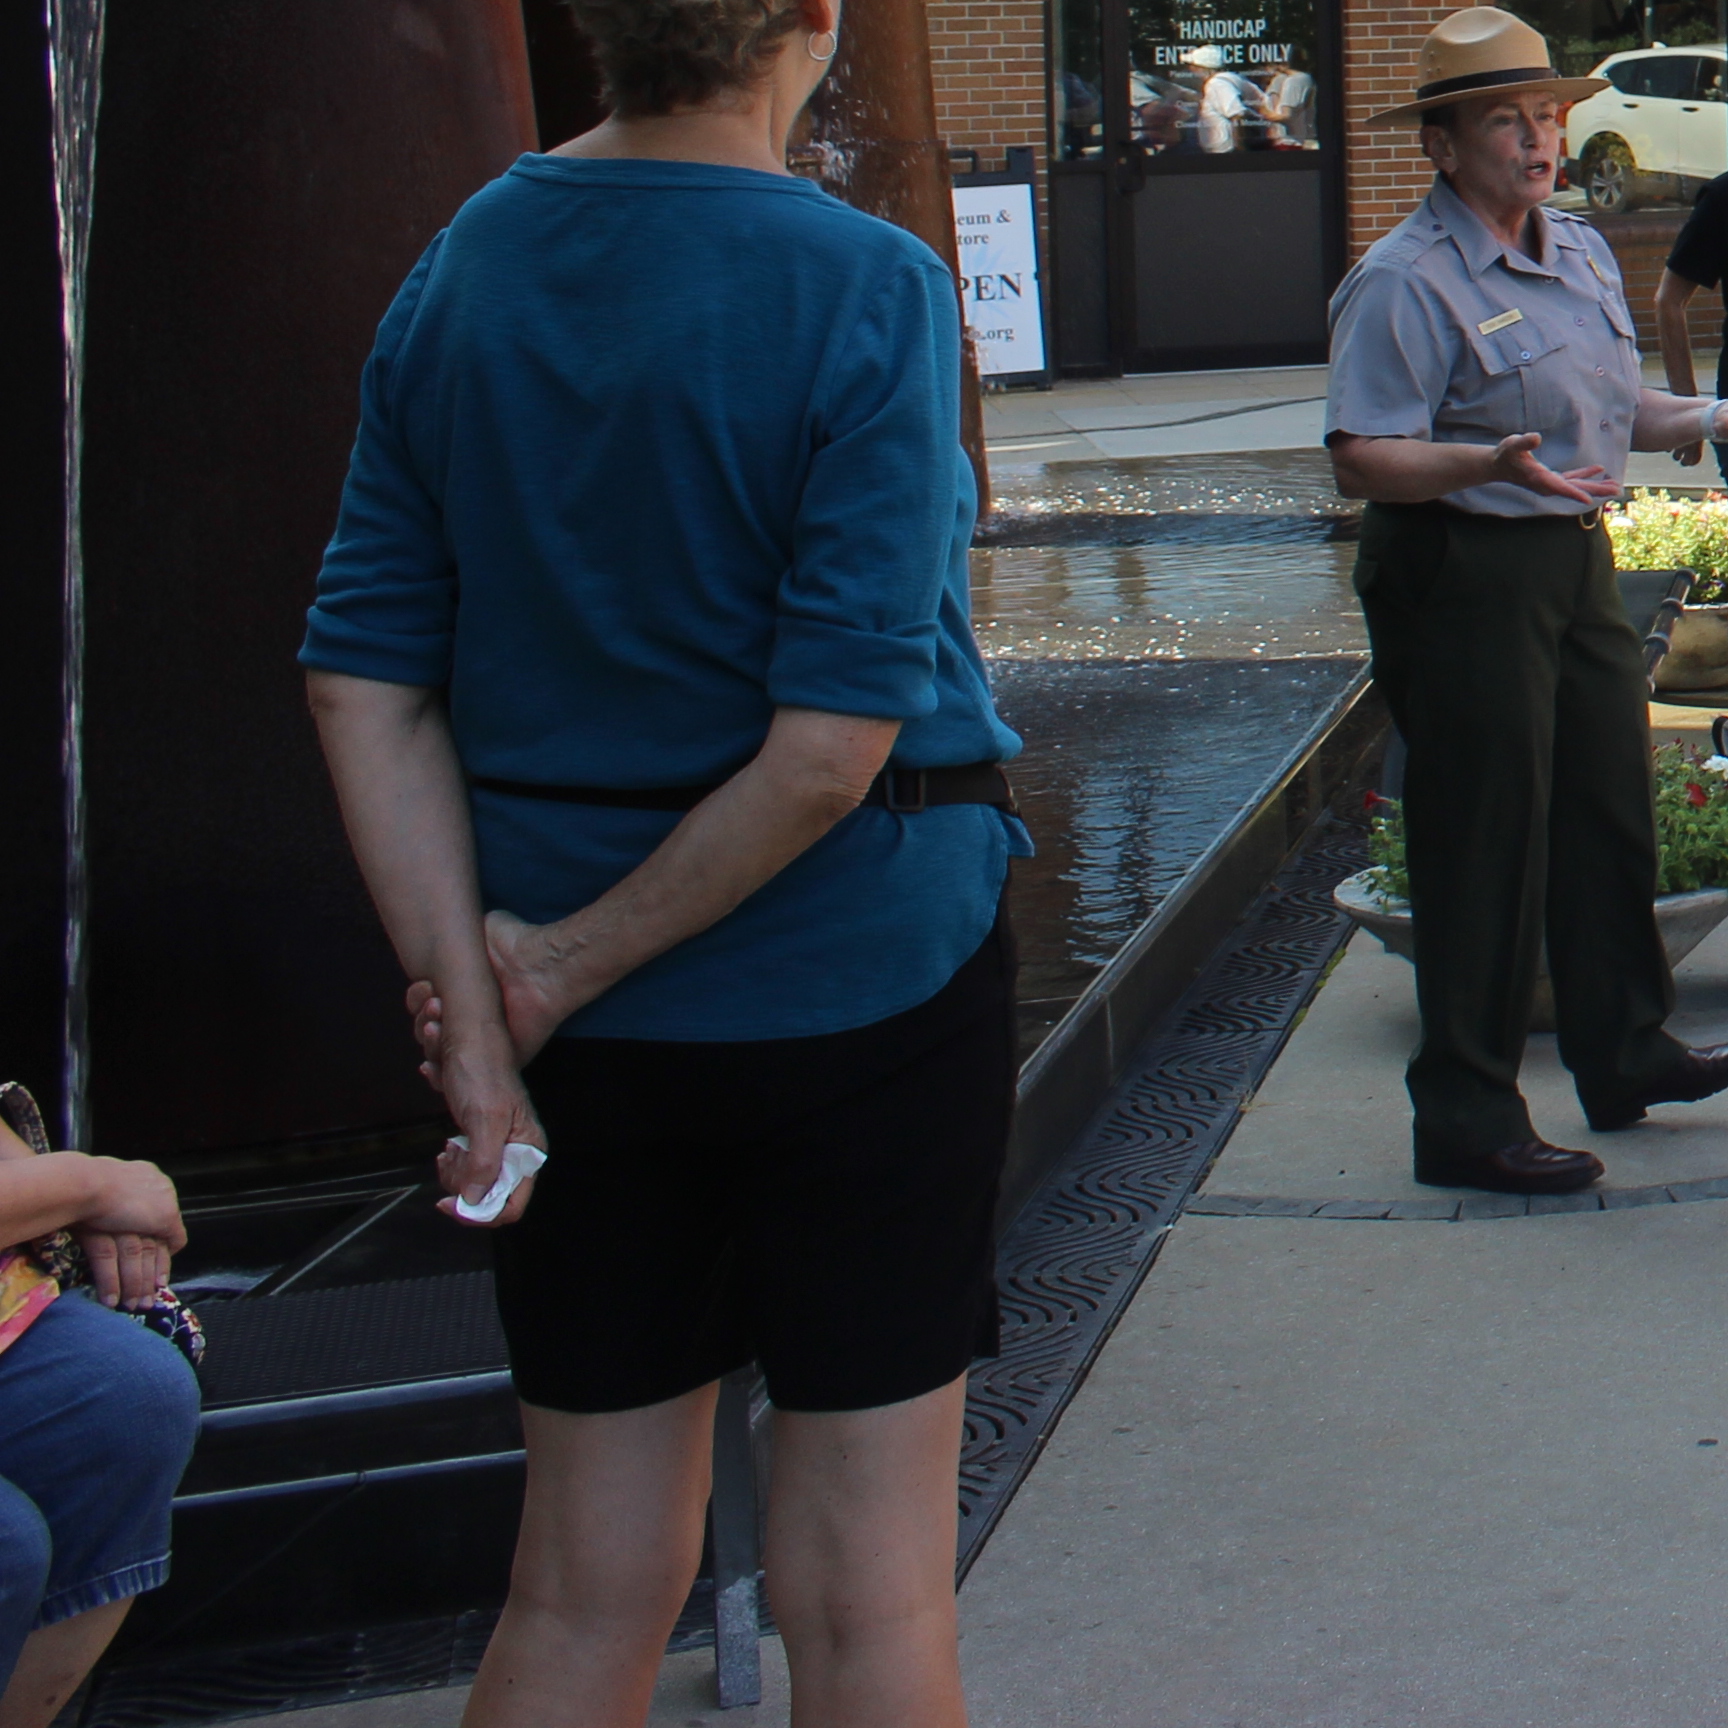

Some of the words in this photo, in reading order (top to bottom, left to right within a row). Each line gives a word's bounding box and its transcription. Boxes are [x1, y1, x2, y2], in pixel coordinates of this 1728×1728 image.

[1180, 19, 1267, 39] HANDICAP
[1155, 44, 1244, 66] ENTCE
[1249, 43, 1292, 64] ONLY
[996, 209, 1012, 224] &
